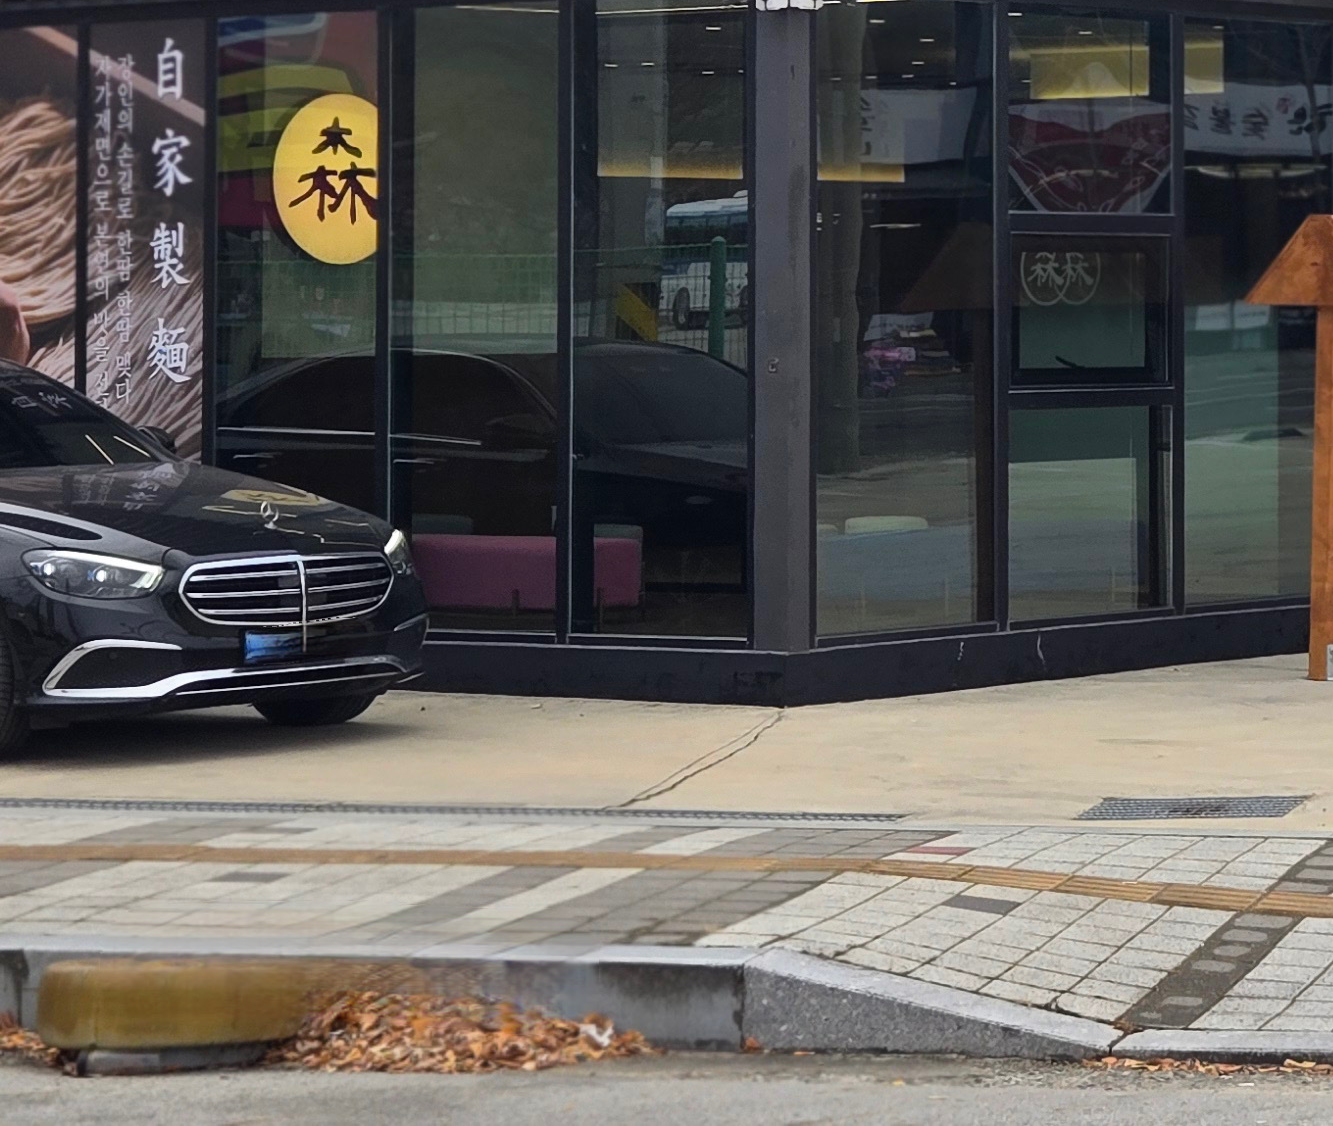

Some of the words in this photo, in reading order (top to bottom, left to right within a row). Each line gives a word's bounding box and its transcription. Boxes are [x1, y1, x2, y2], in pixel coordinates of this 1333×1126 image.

[94, 54, 113, 212] 자가제면으로
[117, 53, 135, 133] 장인의
[116, 142, 134, 219] 손길로
[147, 37, 193, 384] 自家製麵
[289, 116, 379, 225] 森
